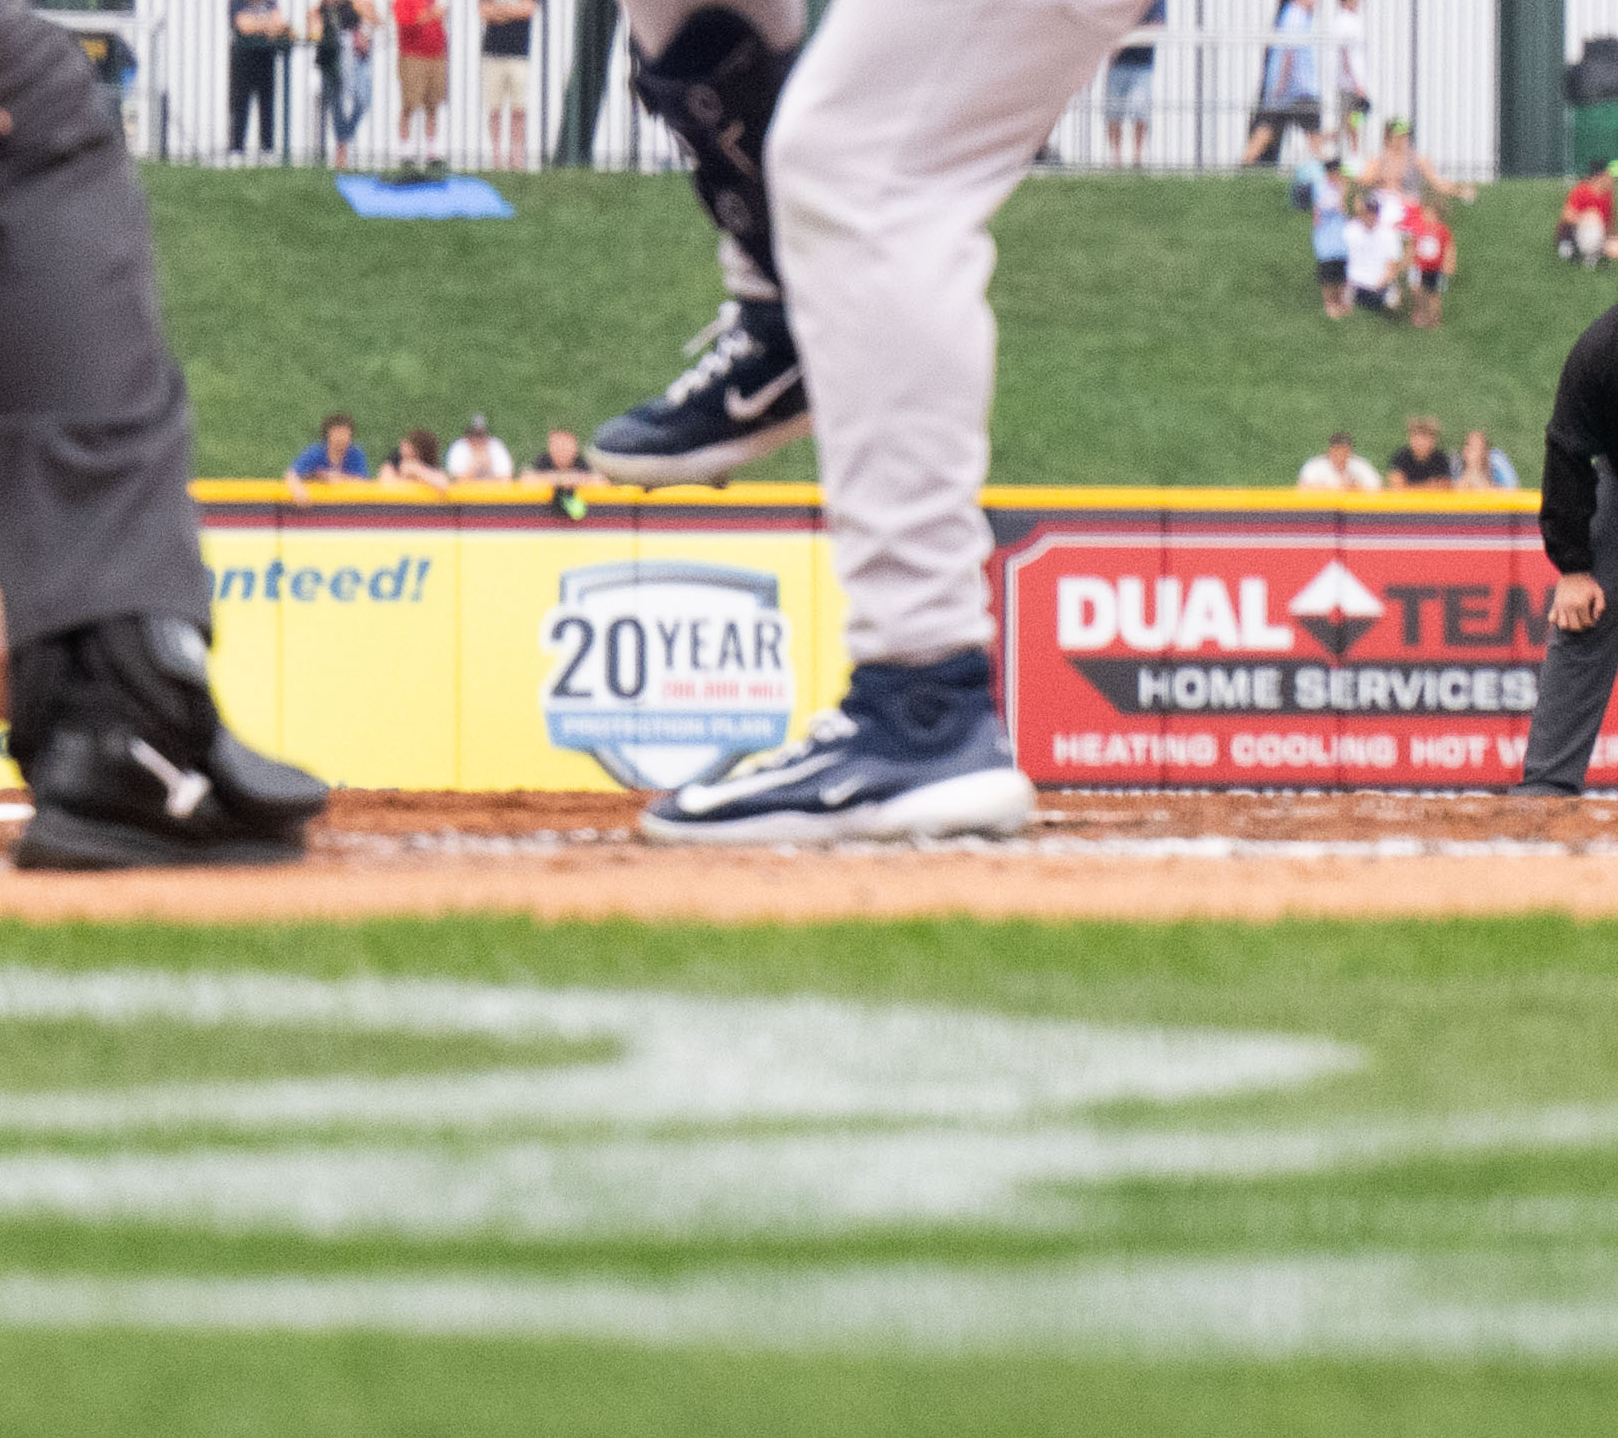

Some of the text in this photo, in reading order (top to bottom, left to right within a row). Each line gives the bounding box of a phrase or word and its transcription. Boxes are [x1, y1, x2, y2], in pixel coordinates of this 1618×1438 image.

[211, 556, 431, 604] nteed!
[1056, 576, 1556, 651] DUAL TEM
[549, 615, 783, 700] 20 YEAR
[1138, 666, 1540, 711] HOME SERVICES
[1053, 733, 1219, 767] HEATING
[1230, 734, 1396, 768] COOLING
[1410, 734, 1488, 768] HOT
